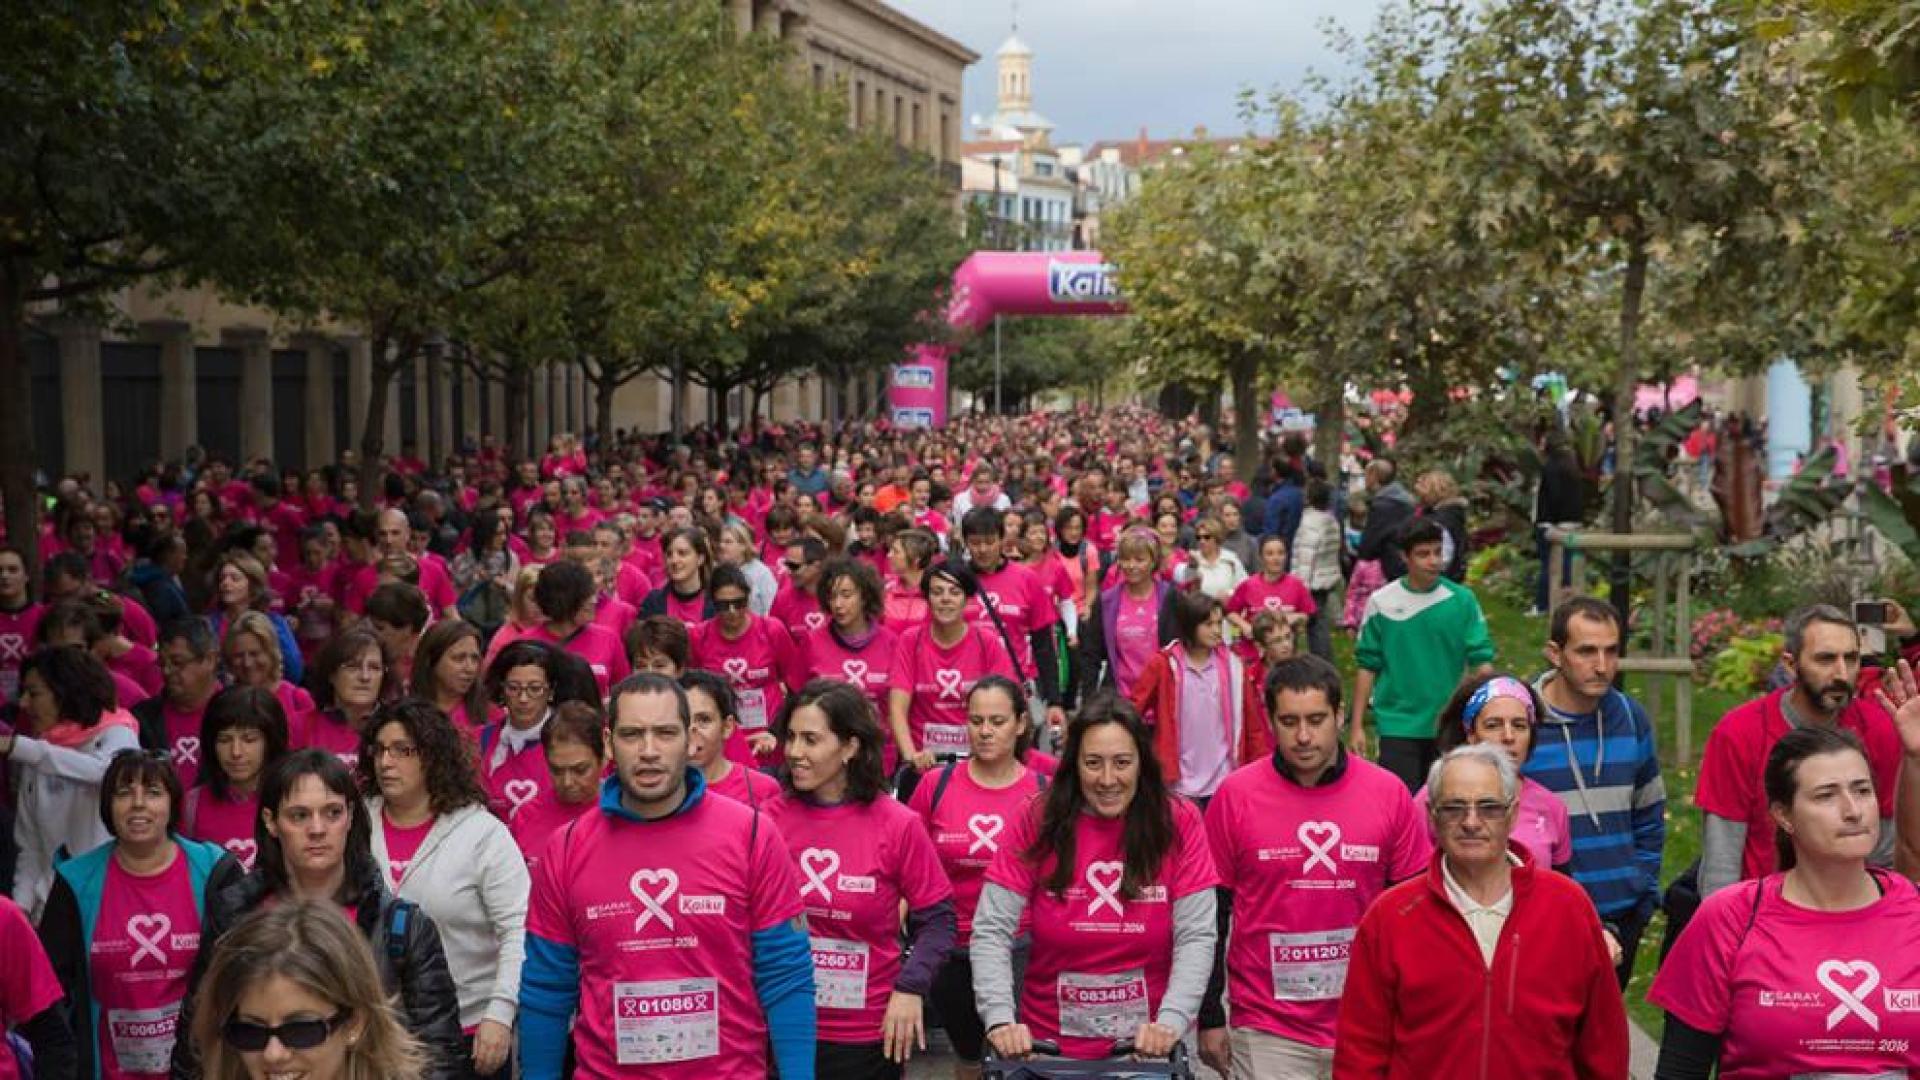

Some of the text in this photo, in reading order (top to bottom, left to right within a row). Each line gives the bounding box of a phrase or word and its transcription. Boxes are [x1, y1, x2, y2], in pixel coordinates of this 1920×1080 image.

[682, 898, 722, 911] Kaiku
[1292, 946, 1339, 960] 01120
[1775, 991, 1821, 1001] SARAY
[1890, 991, 1920, 1009] Kai
[639, 996, 694, 1014] 01086
[1878, 1038, 1910, 1053] 2016
